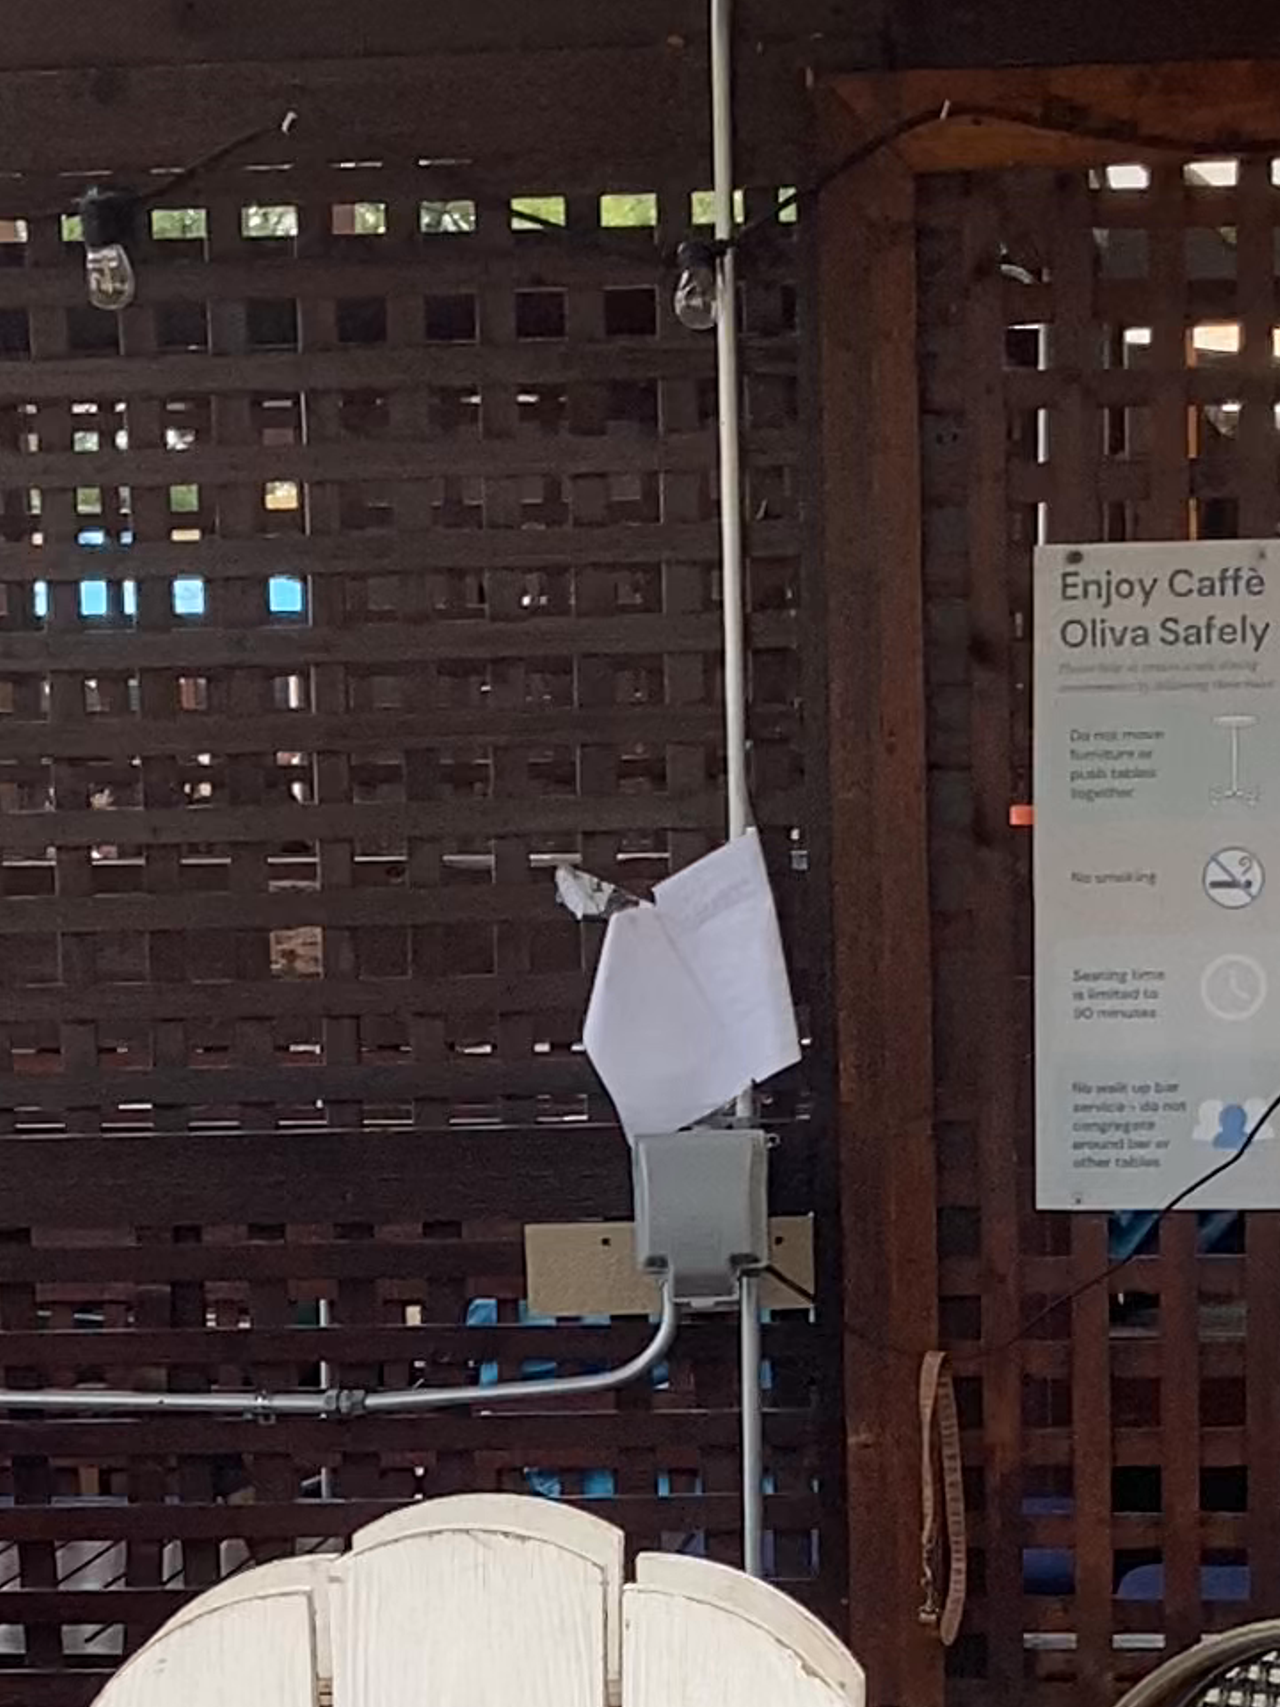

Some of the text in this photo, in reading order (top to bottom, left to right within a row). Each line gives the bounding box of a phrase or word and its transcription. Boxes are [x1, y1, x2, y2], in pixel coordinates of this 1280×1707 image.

[1060, 566, 1266, 608] Enjoy Caffè
[1060, 614, 1270, 653] Oliva Safely
